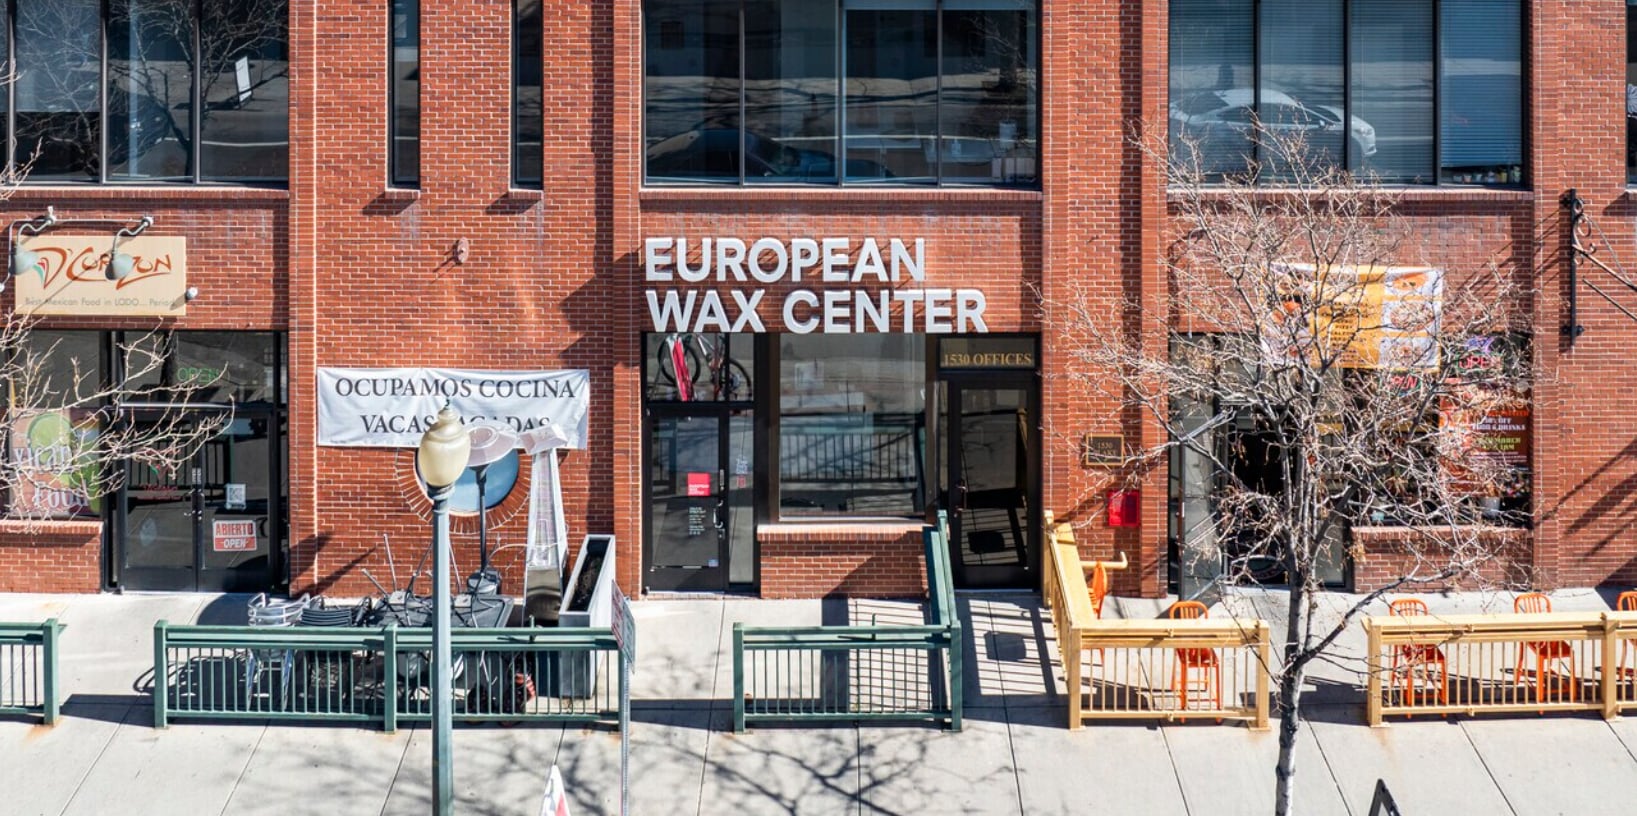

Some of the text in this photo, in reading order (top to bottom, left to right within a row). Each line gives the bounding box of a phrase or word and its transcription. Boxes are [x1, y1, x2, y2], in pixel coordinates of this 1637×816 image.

[645, 237, 925, 282] EUROPEAN
[81, 297, 100, 305] Food
[645, 289, 989, 334] WAX CENTER
[944, 353, 1033, 366] 1530 OFFICES
[335, 377, 575, 398] OCUPAMOS COCINA
[360, 414, 437, 433] VACAS
[215, 523, 253, 536] ABIERTO
[223, 538, 247, 549] OPEN
